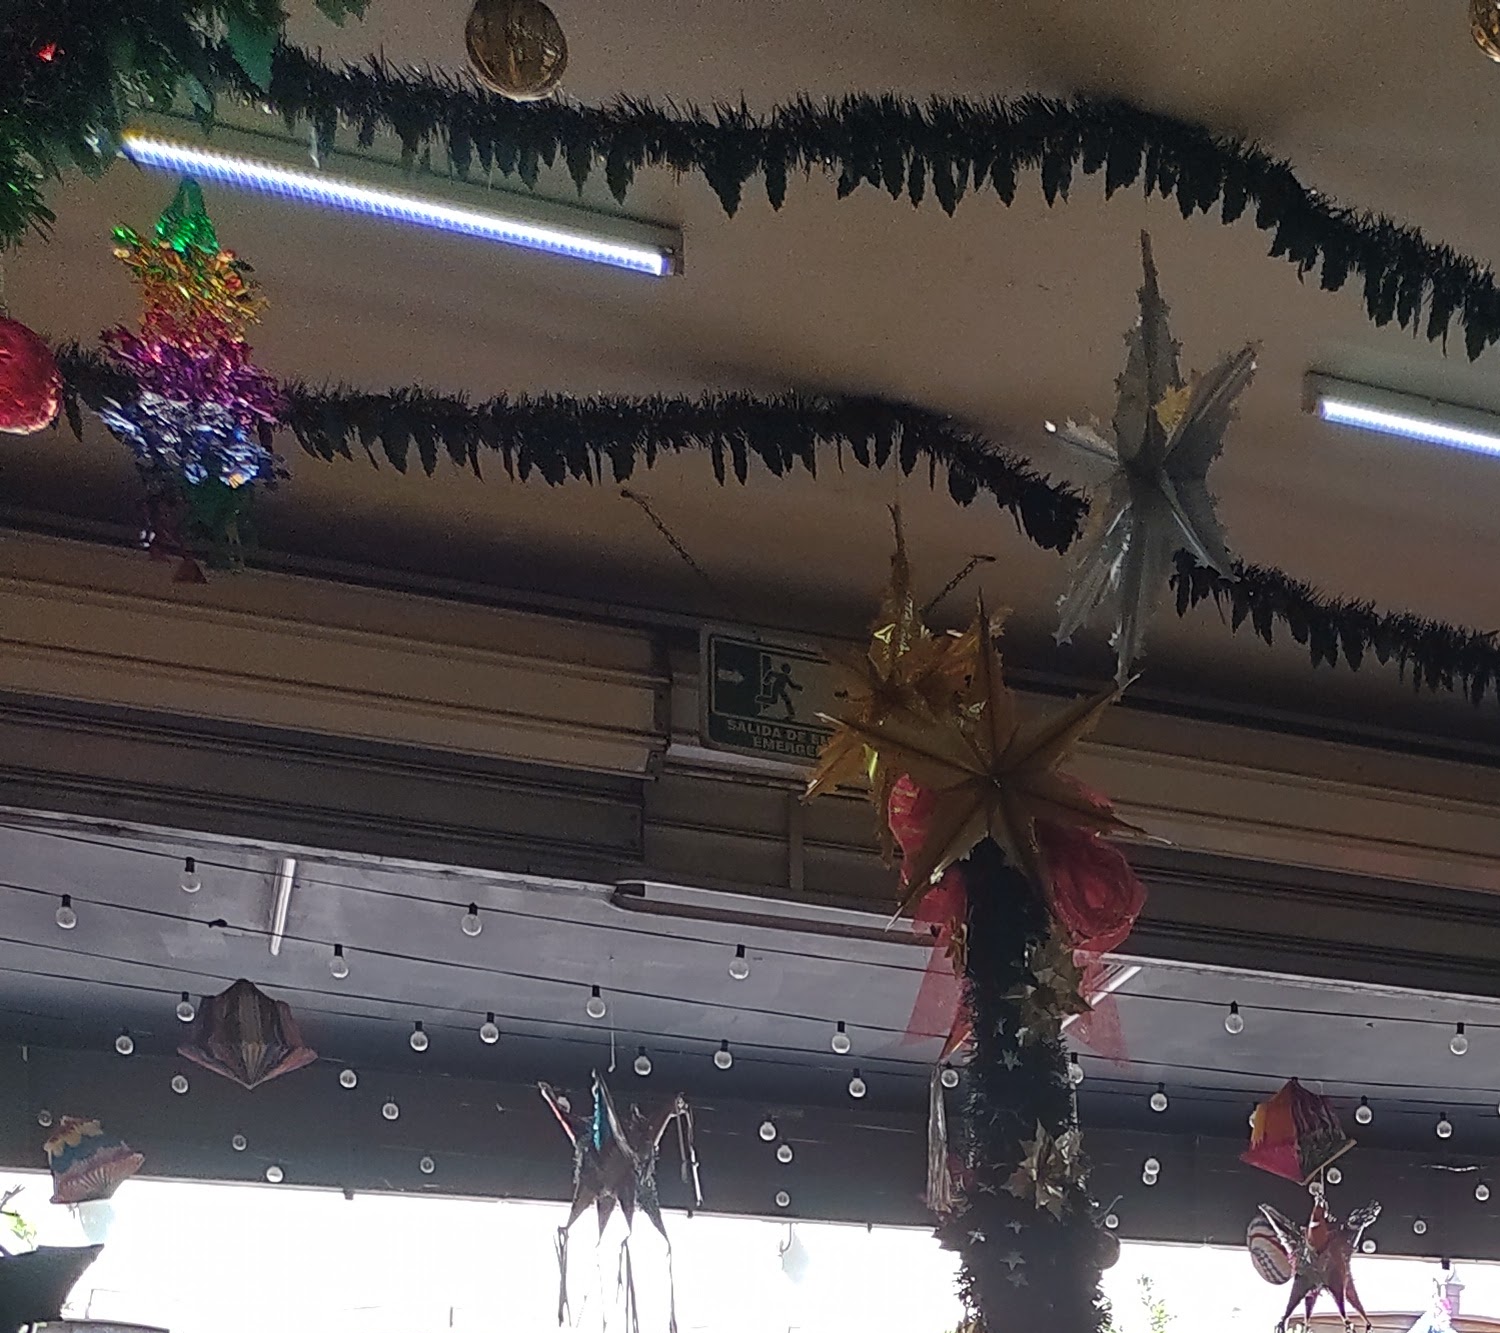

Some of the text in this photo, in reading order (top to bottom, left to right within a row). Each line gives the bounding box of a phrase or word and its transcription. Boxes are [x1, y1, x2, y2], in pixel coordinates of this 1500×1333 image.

[727, 719, 784, 739] SALIDA
[786, 729, 806, 743] DE
[753, 736, 822, 757] EMERGE
